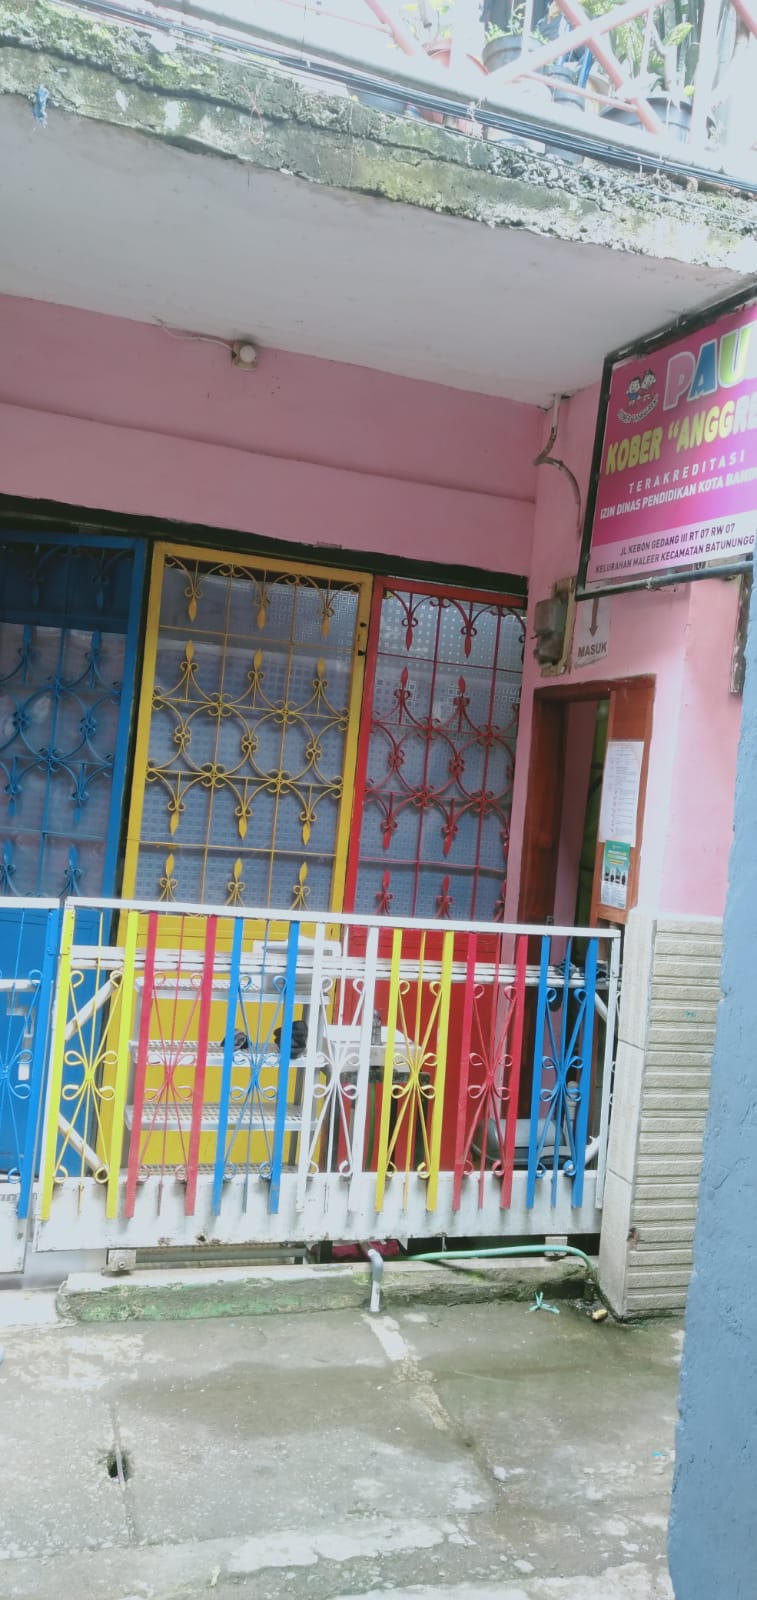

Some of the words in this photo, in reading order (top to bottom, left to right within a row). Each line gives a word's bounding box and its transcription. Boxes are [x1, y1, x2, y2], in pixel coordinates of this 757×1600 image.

[605, 427, 662, 475] KOBER
[629, 449, 745, 494] TERAKREDITASI
[600, 506, 615, 520] IZIN
[616, 499, 641, 516] DINAS
[642, 485, 696, 508] PENDIDIKAN
[697, 477, 724, 494] KOTA
[628, 541, 650, 555] KEBON
[651, 535, 680, 549] GEDANG
[689, 530, 699, 541] RT
[700, 527, 710, 538] 07
[711, 525, 724, 537] RW
[725, 522, 736, 534] 07
[595, 559, 632, 574] KELURAHAN
[633, 552, 660, 567] MALEER
[660, 544, 704, 561] KECAMATAN
[577, 641, 607, 657] MASUK
